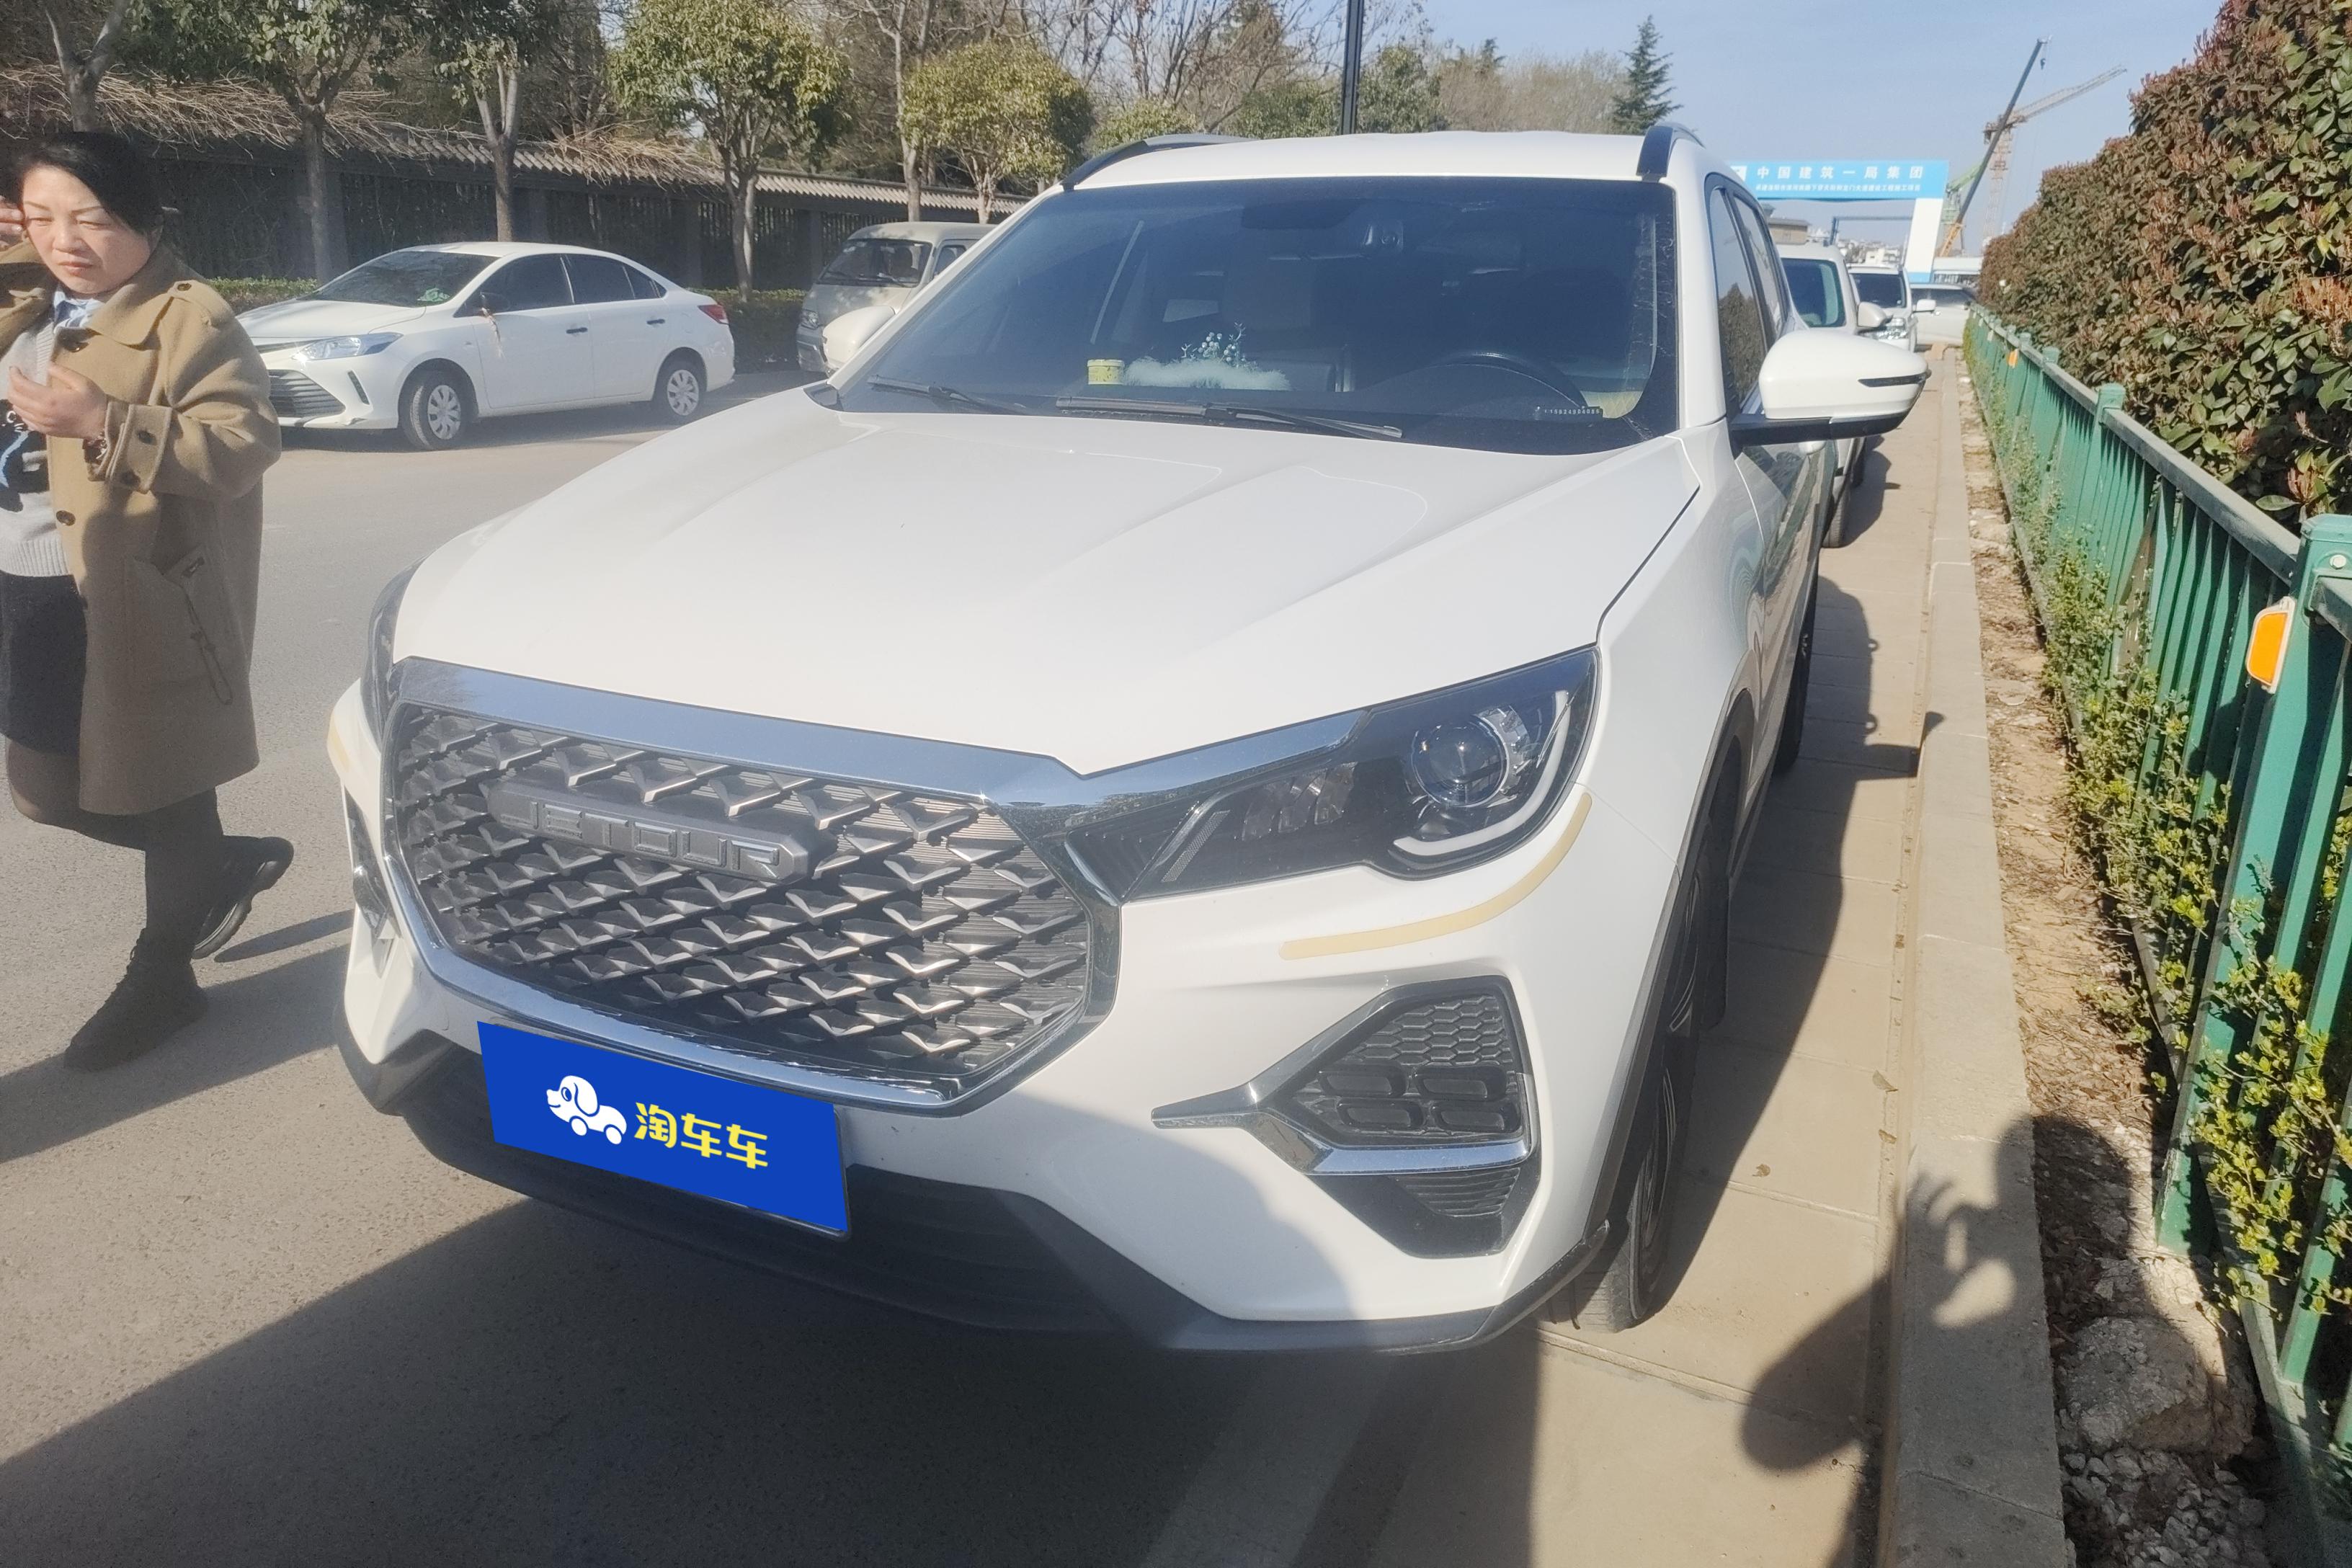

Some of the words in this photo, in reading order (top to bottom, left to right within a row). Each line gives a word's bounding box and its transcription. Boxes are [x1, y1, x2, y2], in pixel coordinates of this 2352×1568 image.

[1757, 166, 1923, 179] 中国建筑一局集团
[499, 801, 780, 880] JETOUR
